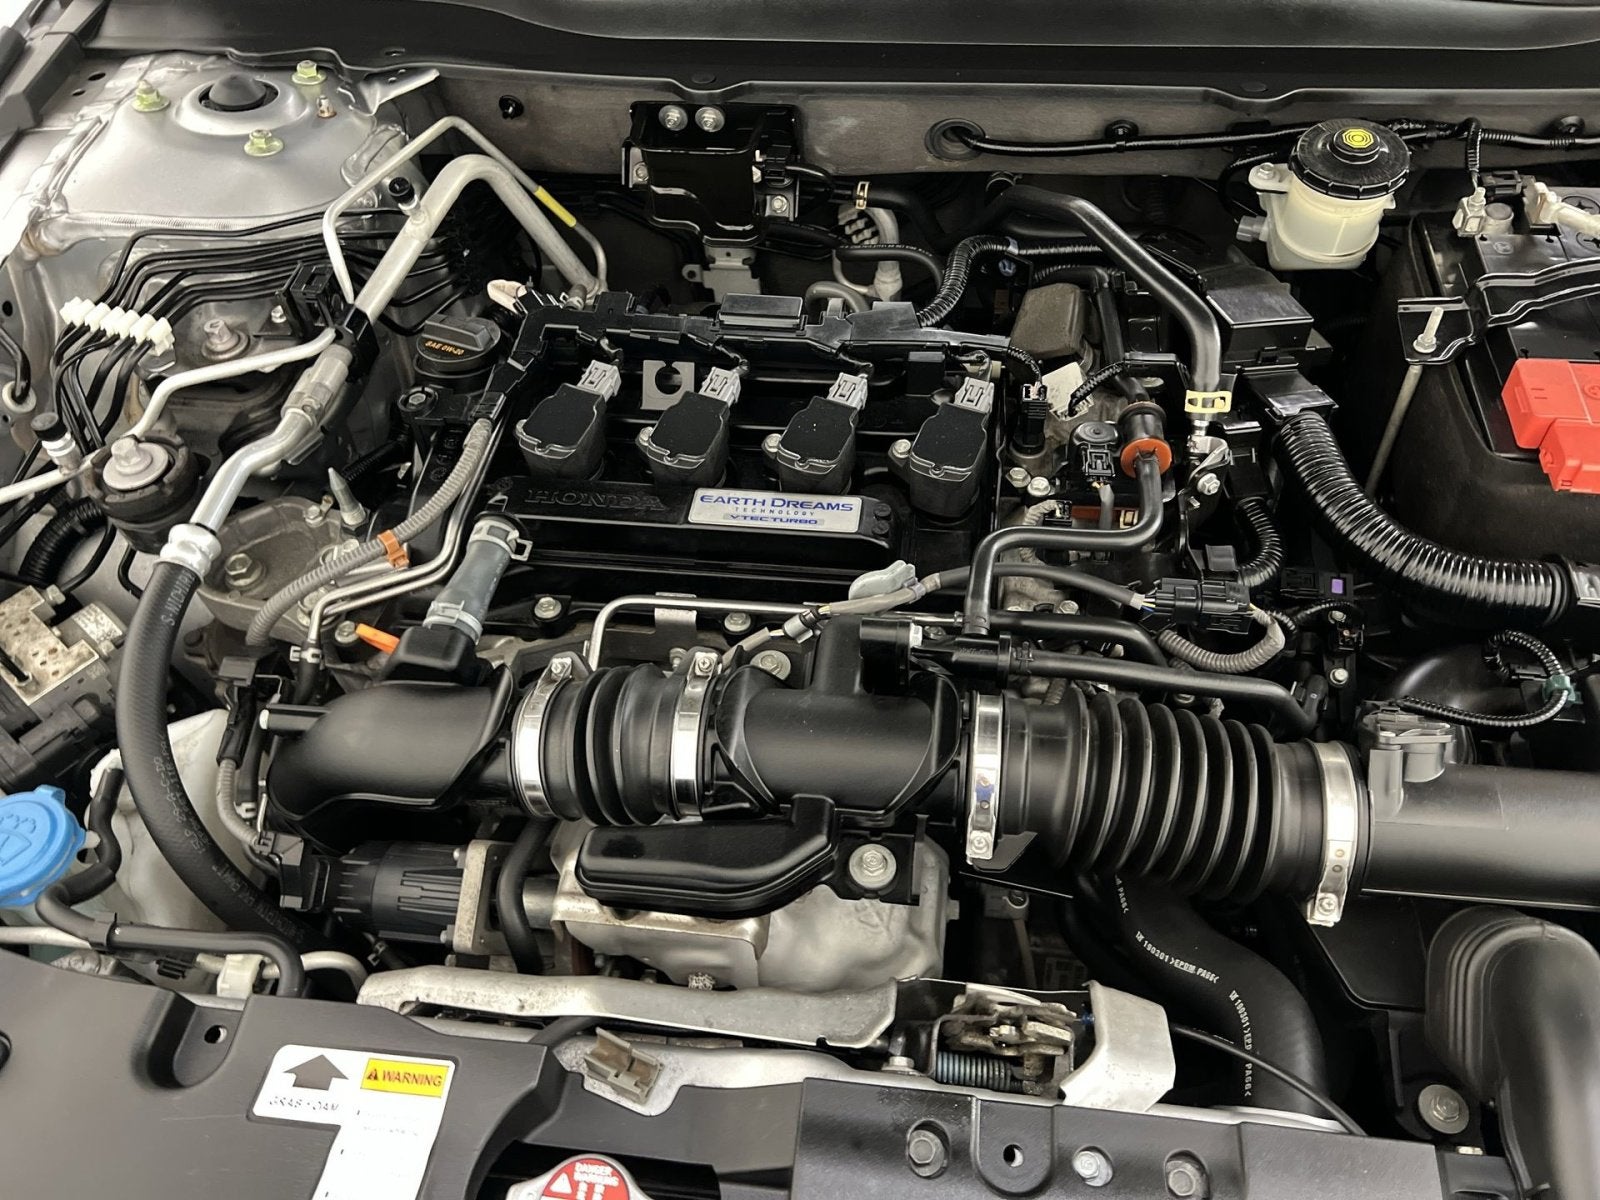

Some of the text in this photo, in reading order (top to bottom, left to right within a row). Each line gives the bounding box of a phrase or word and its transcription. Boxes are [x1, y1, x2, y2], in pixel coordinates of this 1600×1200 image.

[524, 489, 667, 511] HONDA
[700, 494, 854, 512] EARTH DREAMS
[735, 506, 816, 517] TECHNOLOGY
[382, 1069, 443, 1088] WARNING
